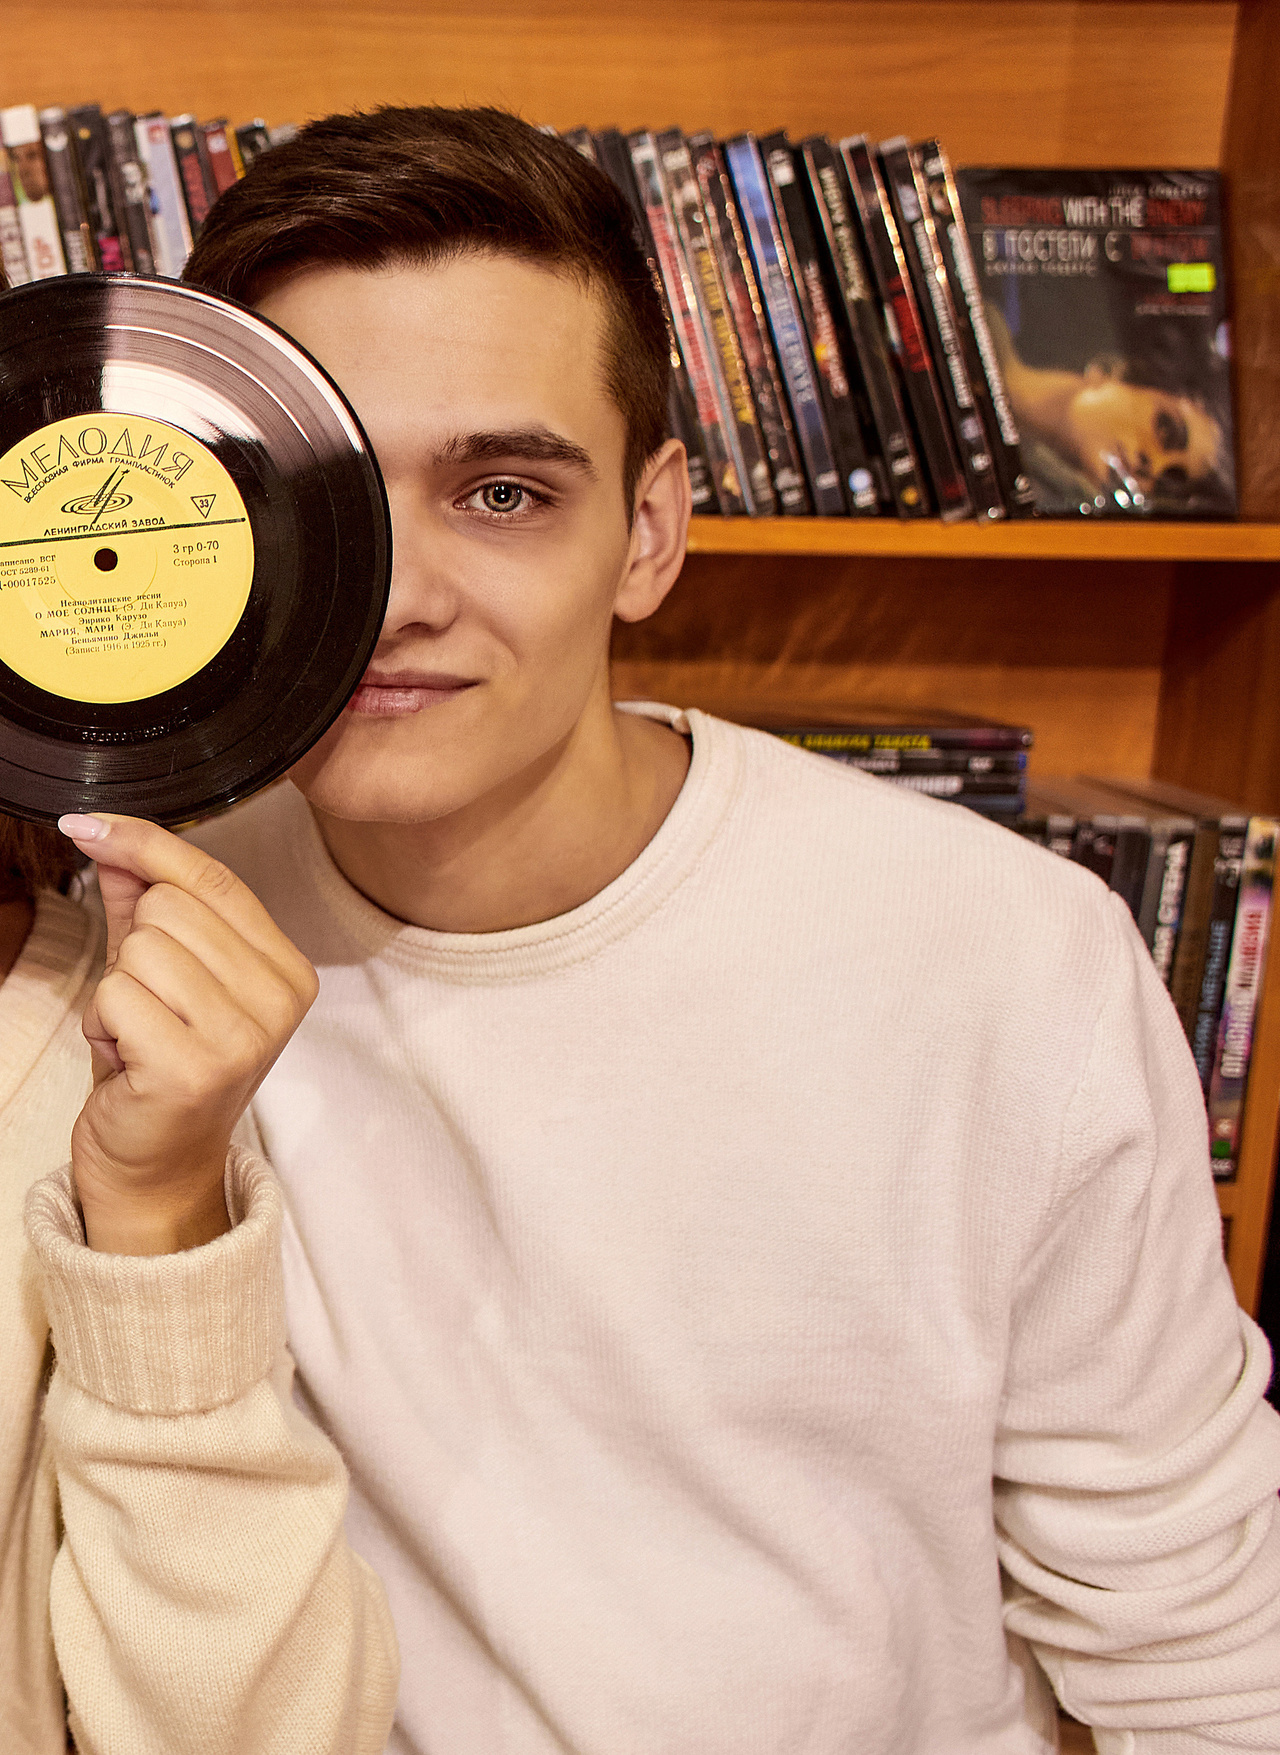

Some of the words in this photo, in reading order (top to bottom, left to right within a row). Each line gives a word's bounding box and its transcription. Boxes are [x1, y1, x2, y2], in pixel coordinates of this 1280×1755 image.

[0, 427, 194, 498] МЕЛОДИЯ
[23, 465, 69, 504] ВСЕСОЮЗНАЯ
[72, 456, 104, 468] ФИРМА
[109, 456, 176, 489] ГРАМПЛАСТИНОК
[199, 499, 210, 509] 33
[43, 519, 128, 536] ЛЕНИНГРАДСКИЙ
[131, 516, 166, 528] ЗАВОД
[182, 544, 194, 555] гр
[196, 540, 220, 552] 0-70
[19, 565, 50, 575] 5289-61
[173, 558, 210, 568] Сторона
[60, 596, 132, 607] Неаполитанские
[136, 592, 162, 601] песни
[35, 611, 43, 620] О
[46, 609, 70, 619] МОЕ
[73, 604, 119, 616] СОЛНЦЕ
[123, 603, 136, 613] (Э.
[139, 601, 154, 611] Ди
[155, 598, 188, 610] Капуа)
[78, 616, 111, 626] Энрико
[115, 612, 148, 622] Карузо
[40, 627, 80, 639] МАРИЯ,
[84, 623, 114, 634] МАРИ
[121, 622, 135, 632] (Э.
[139, 620, 153, 630] Ди
[155, 617, 187, 629] Капуа)
[71, 635, 119, 645] Беньямино
[122, 631, 159, 641] Джильи
[65, 646, 100, 656] (Записи
[131, 640, 151, 649] 1925
[152, 638, 167, 648] гг.)
